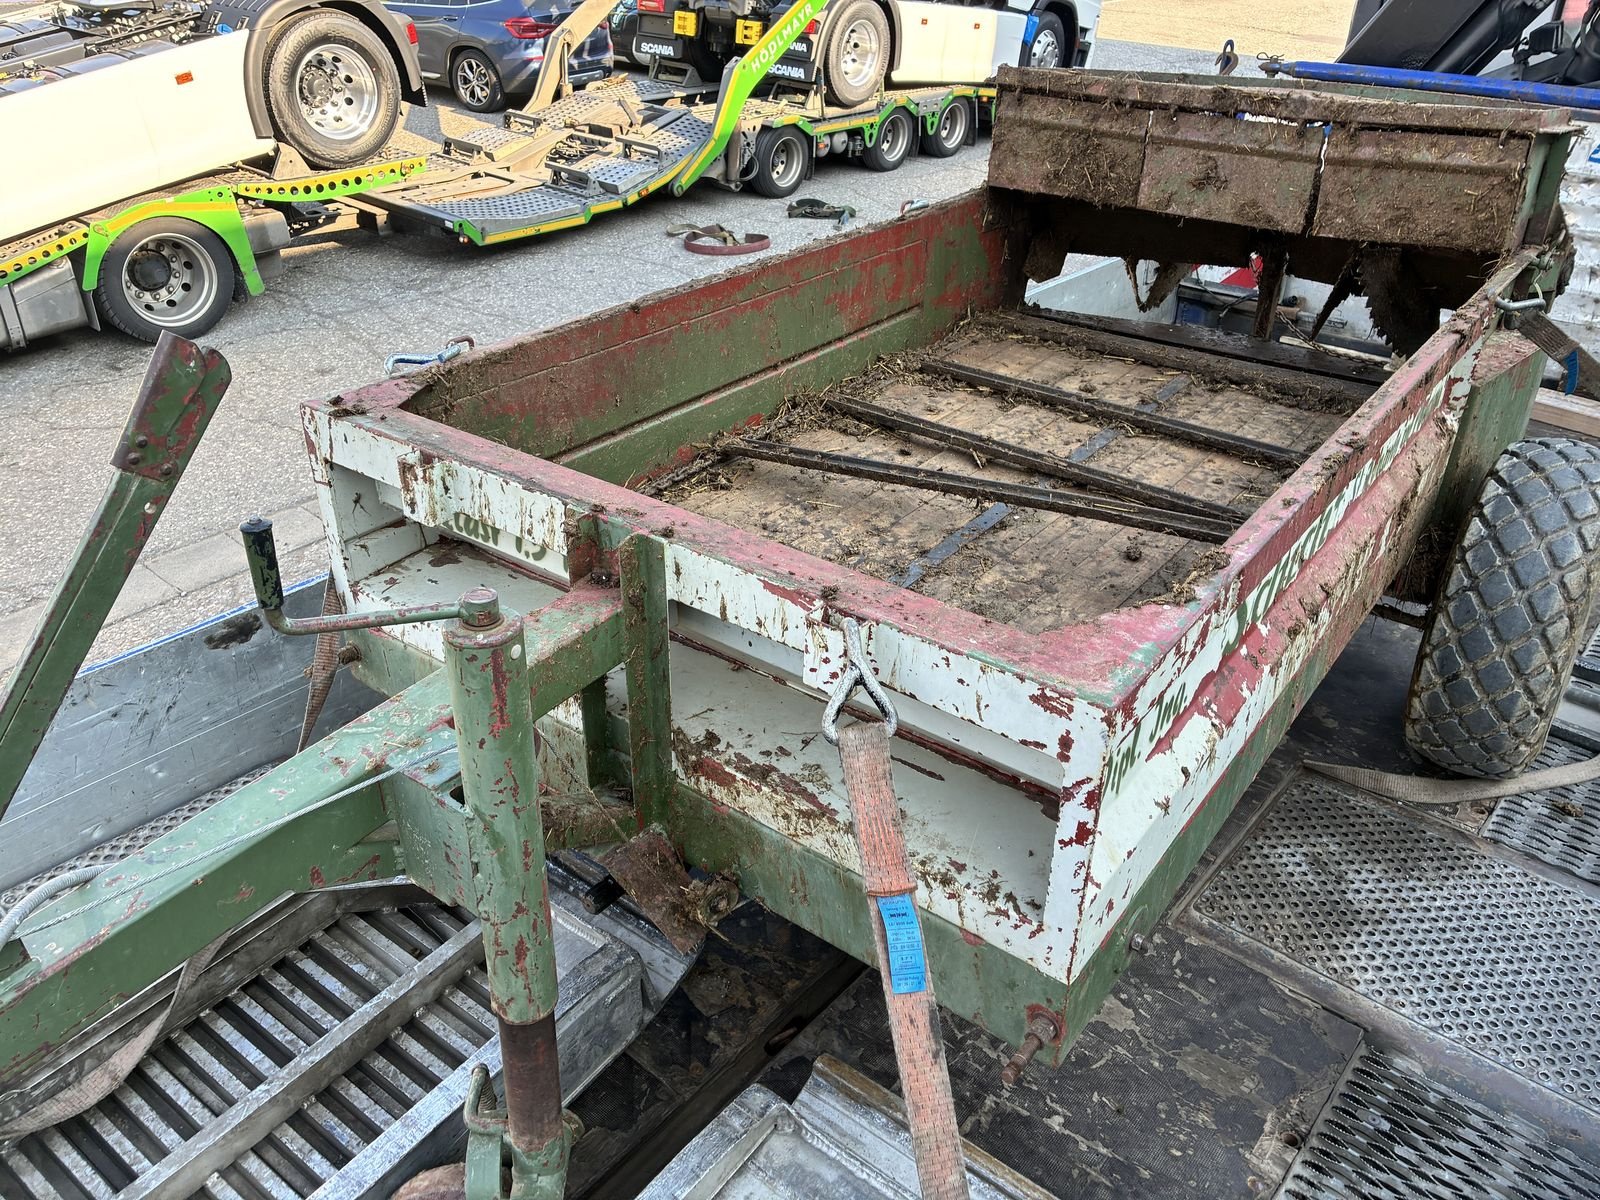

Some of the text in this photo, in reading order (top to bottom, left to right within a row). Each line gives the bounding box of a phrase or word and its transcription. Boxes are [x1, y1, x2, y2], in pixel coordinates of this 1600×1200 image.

[280, 29, 315, 86] Continental
[640, 42, 675, 56] SCANIA
[751, 3, 814, 73] HÖDLMAYR
